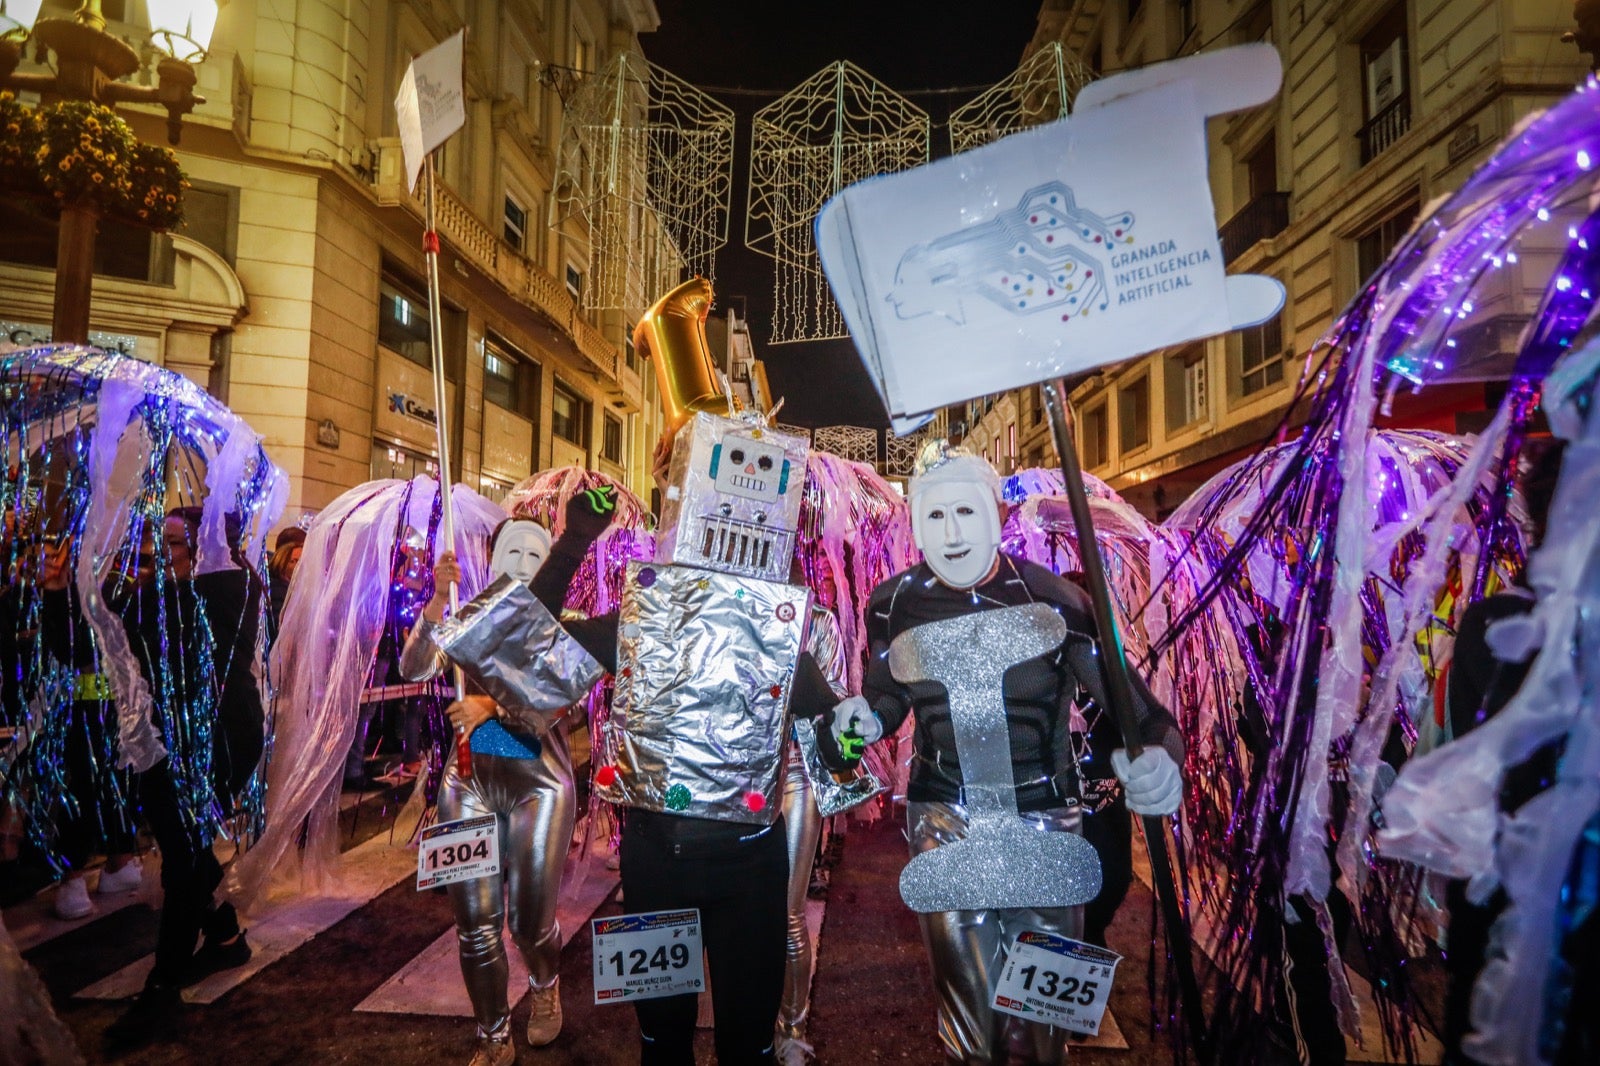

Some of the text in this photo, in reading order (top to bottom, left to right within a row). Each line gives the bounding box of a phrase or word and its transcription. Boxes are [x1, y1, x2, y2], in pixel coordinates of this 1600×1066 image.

[1110, 239, 1177, 269] GRANADA
[1114, 249, 1211, 287] INTELIGENCIA
[1118, 275, 1192, 305] ARTIFICIAL
[428, 839, 488, 869] 1304
[609, 943, 690, 976] 1249
[1020, 964, 1098, 1007] 1325
